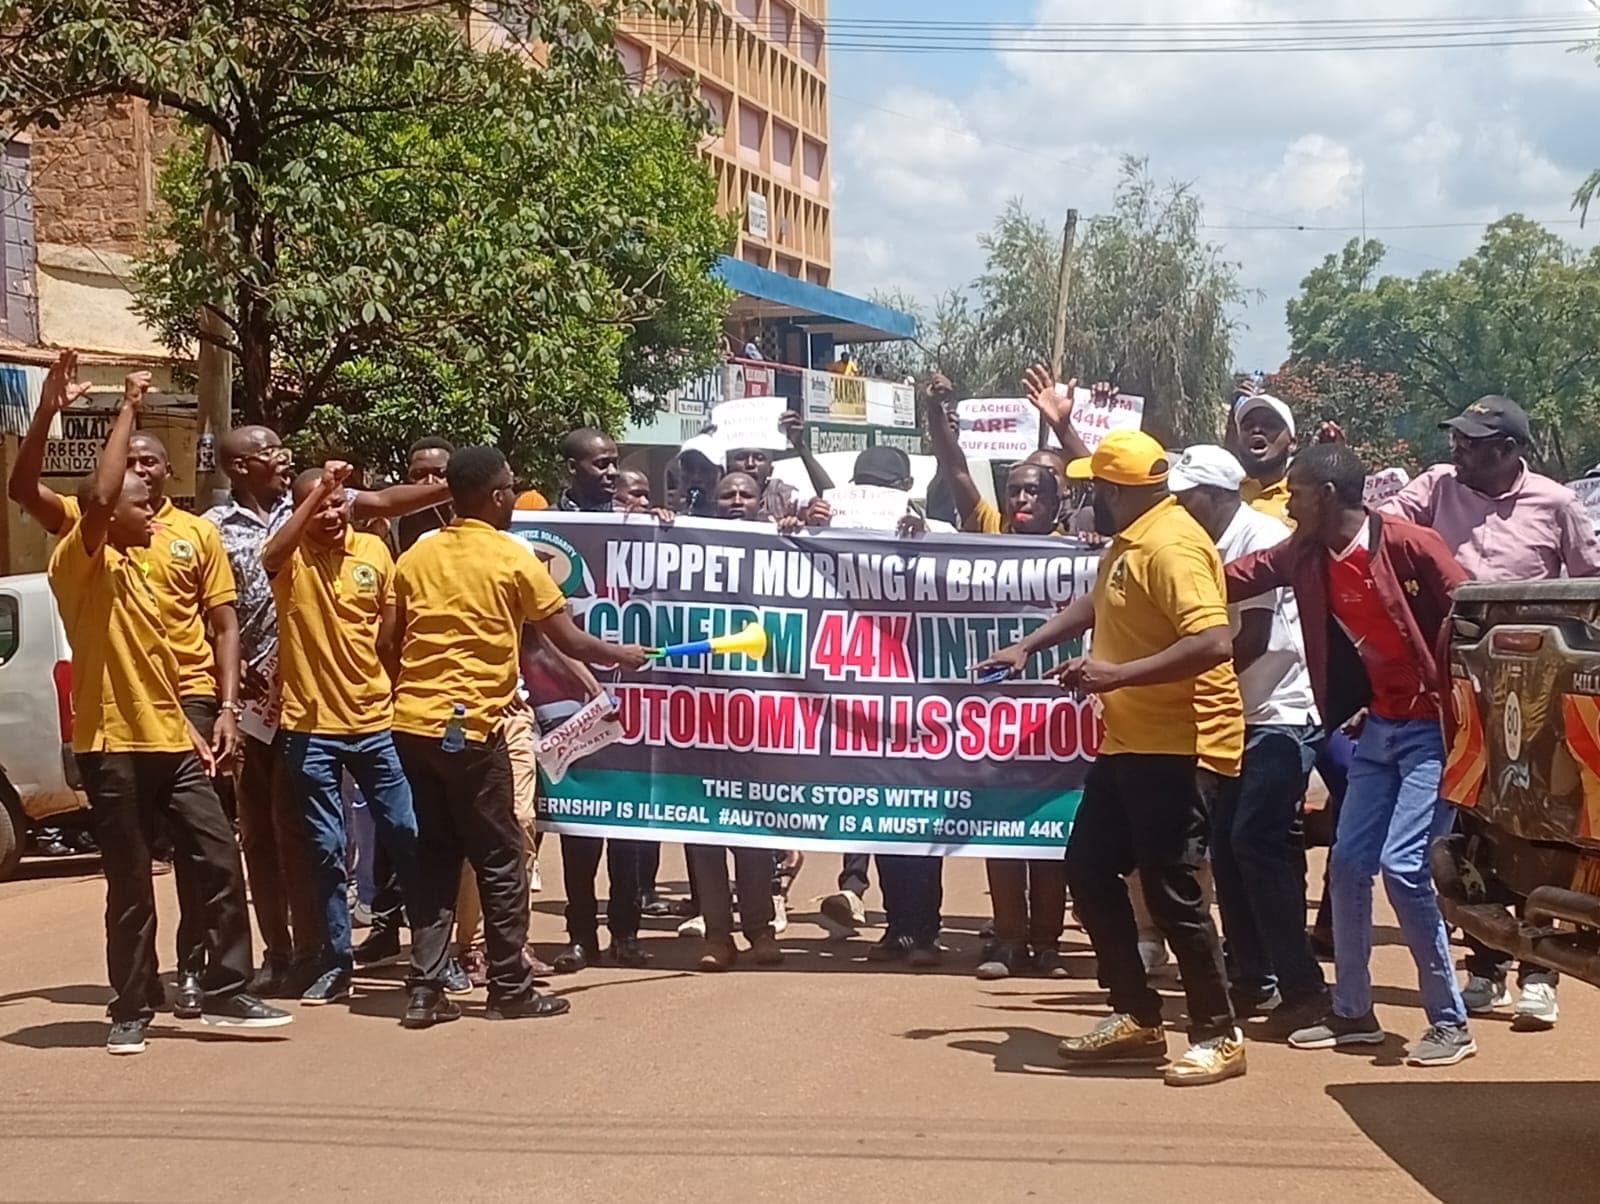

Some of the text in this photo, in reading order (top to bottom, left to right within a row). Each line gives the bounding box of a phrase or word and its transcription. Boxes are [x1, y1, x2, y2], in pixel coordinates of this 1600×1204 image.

[964, 403, 1029, 413] TEACHERS
[1072, 409, 1110, 429] 44K
[64, 417, 111, 440] OMAT
[971, 418, 1018, 433] ARE
[47, 442, 97, 457] RBERS
[962, 441, 1028, 451] SUFFERING
[44, 457, 97, 470] INYOZI
[606, 540, 1100, 602] KUPPET MURANG'A BRANCH
[586, 601, 806, 679] CONFIRM
[811, 610, 915, 683] 44K
[540, 703, 603, 753] CONFIRM
[614, 685, 829, 754] UTONOMY
[831, 695, 884, 756] IN
[888, 696, 952, 759] J.S
[956, 697, 1100, 762] SCHOO
[703, 779, 972, 808] THE BUCK STOPS WITH US
[537, 796, 611, 817] ERNSHIP
[616, 802, 633, 818] IS
[638, 803, 710, 824] ILLEGAL
[718, 808, 829, 831] #AUTONOMY
[839, 816, 857, 832] IS
[860, 817, 872, 833] A
[878, 818, 928, 835] MUST
[932, 819, 1025, 838] #CONFIRM
[1029, 820, 1064, 839] 44K
